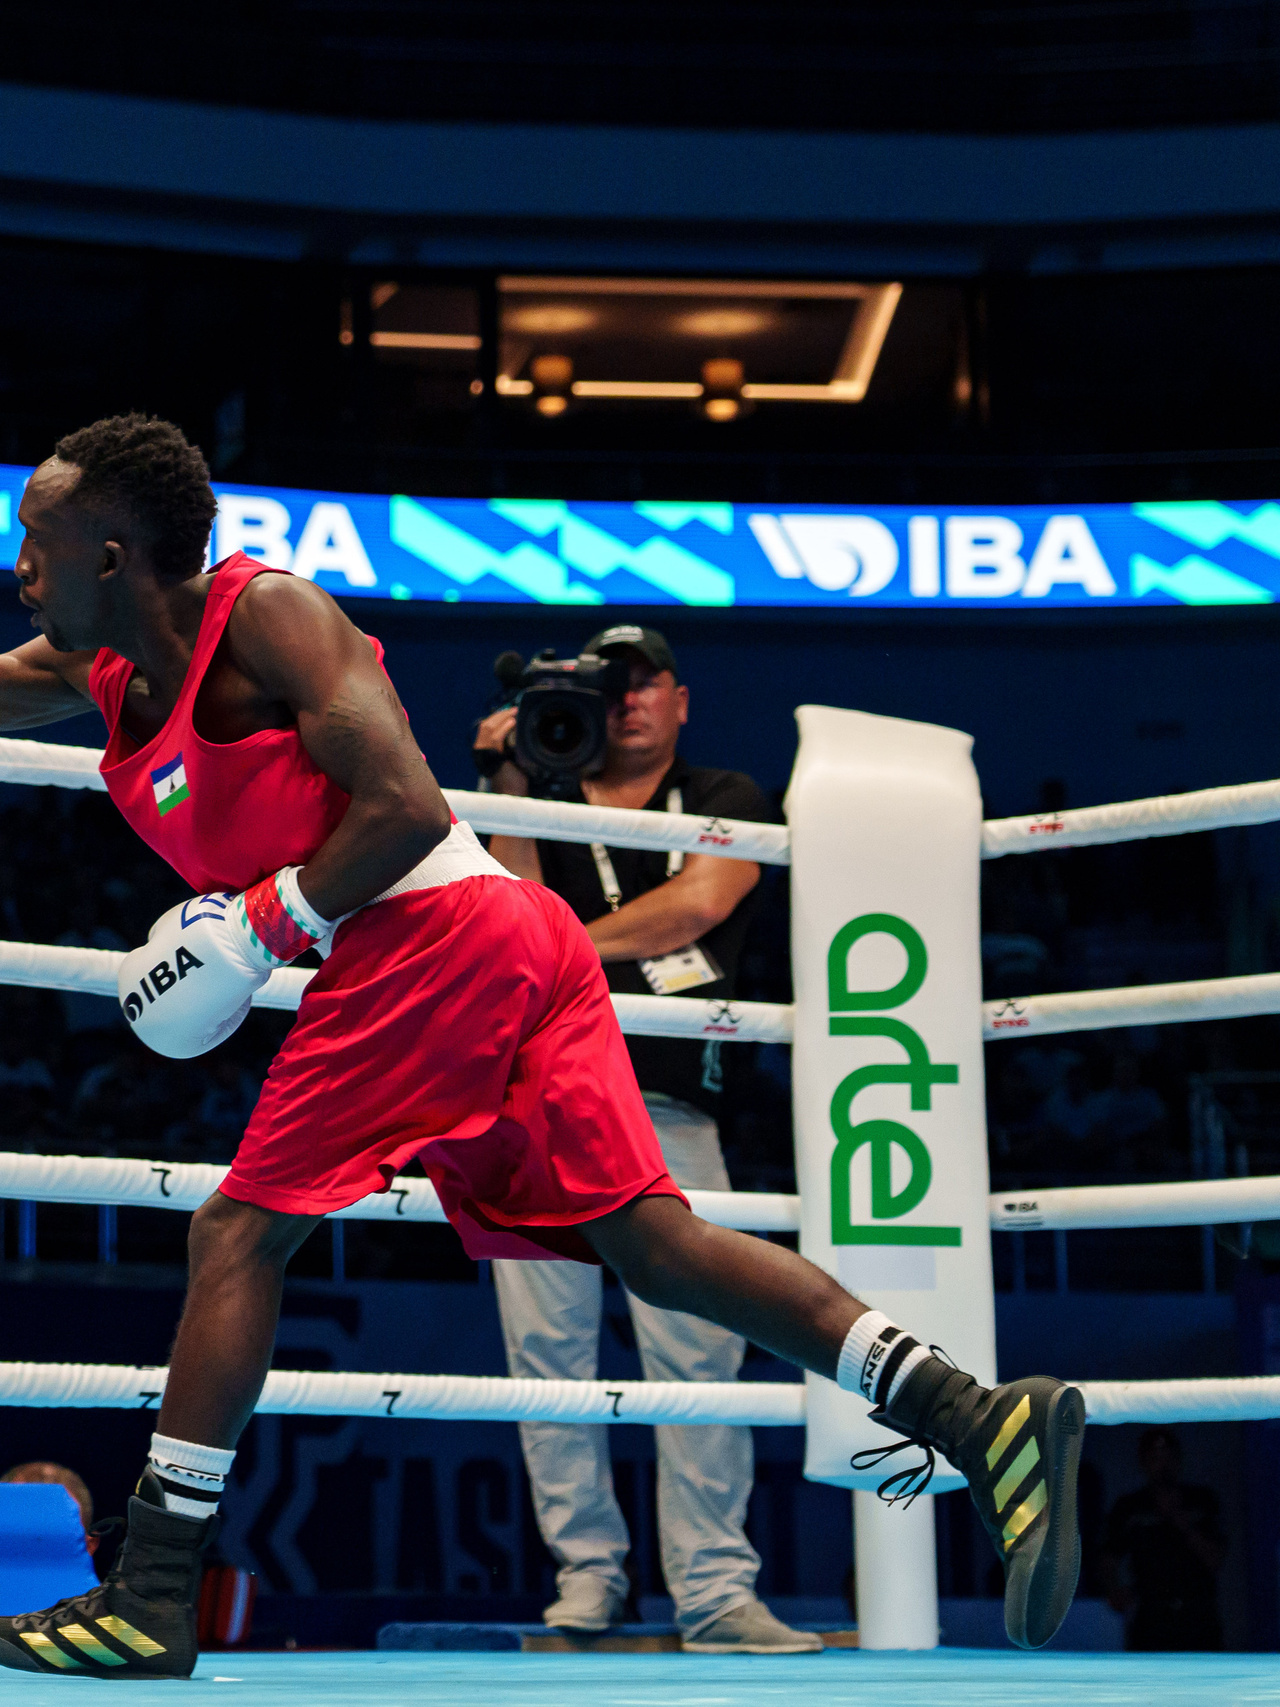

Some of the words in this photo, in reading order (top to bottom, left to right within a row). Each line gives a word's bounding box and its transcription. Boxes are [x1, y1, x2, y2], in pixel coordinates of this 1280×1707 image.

[203, 493, 379, 598] BA
[907, 514, 1118, 598] IBA
[139, 945, 205, 1004] IBA
[827, 912, 963, 1247] artel
[860, 1342, 887, 1400] ANS
